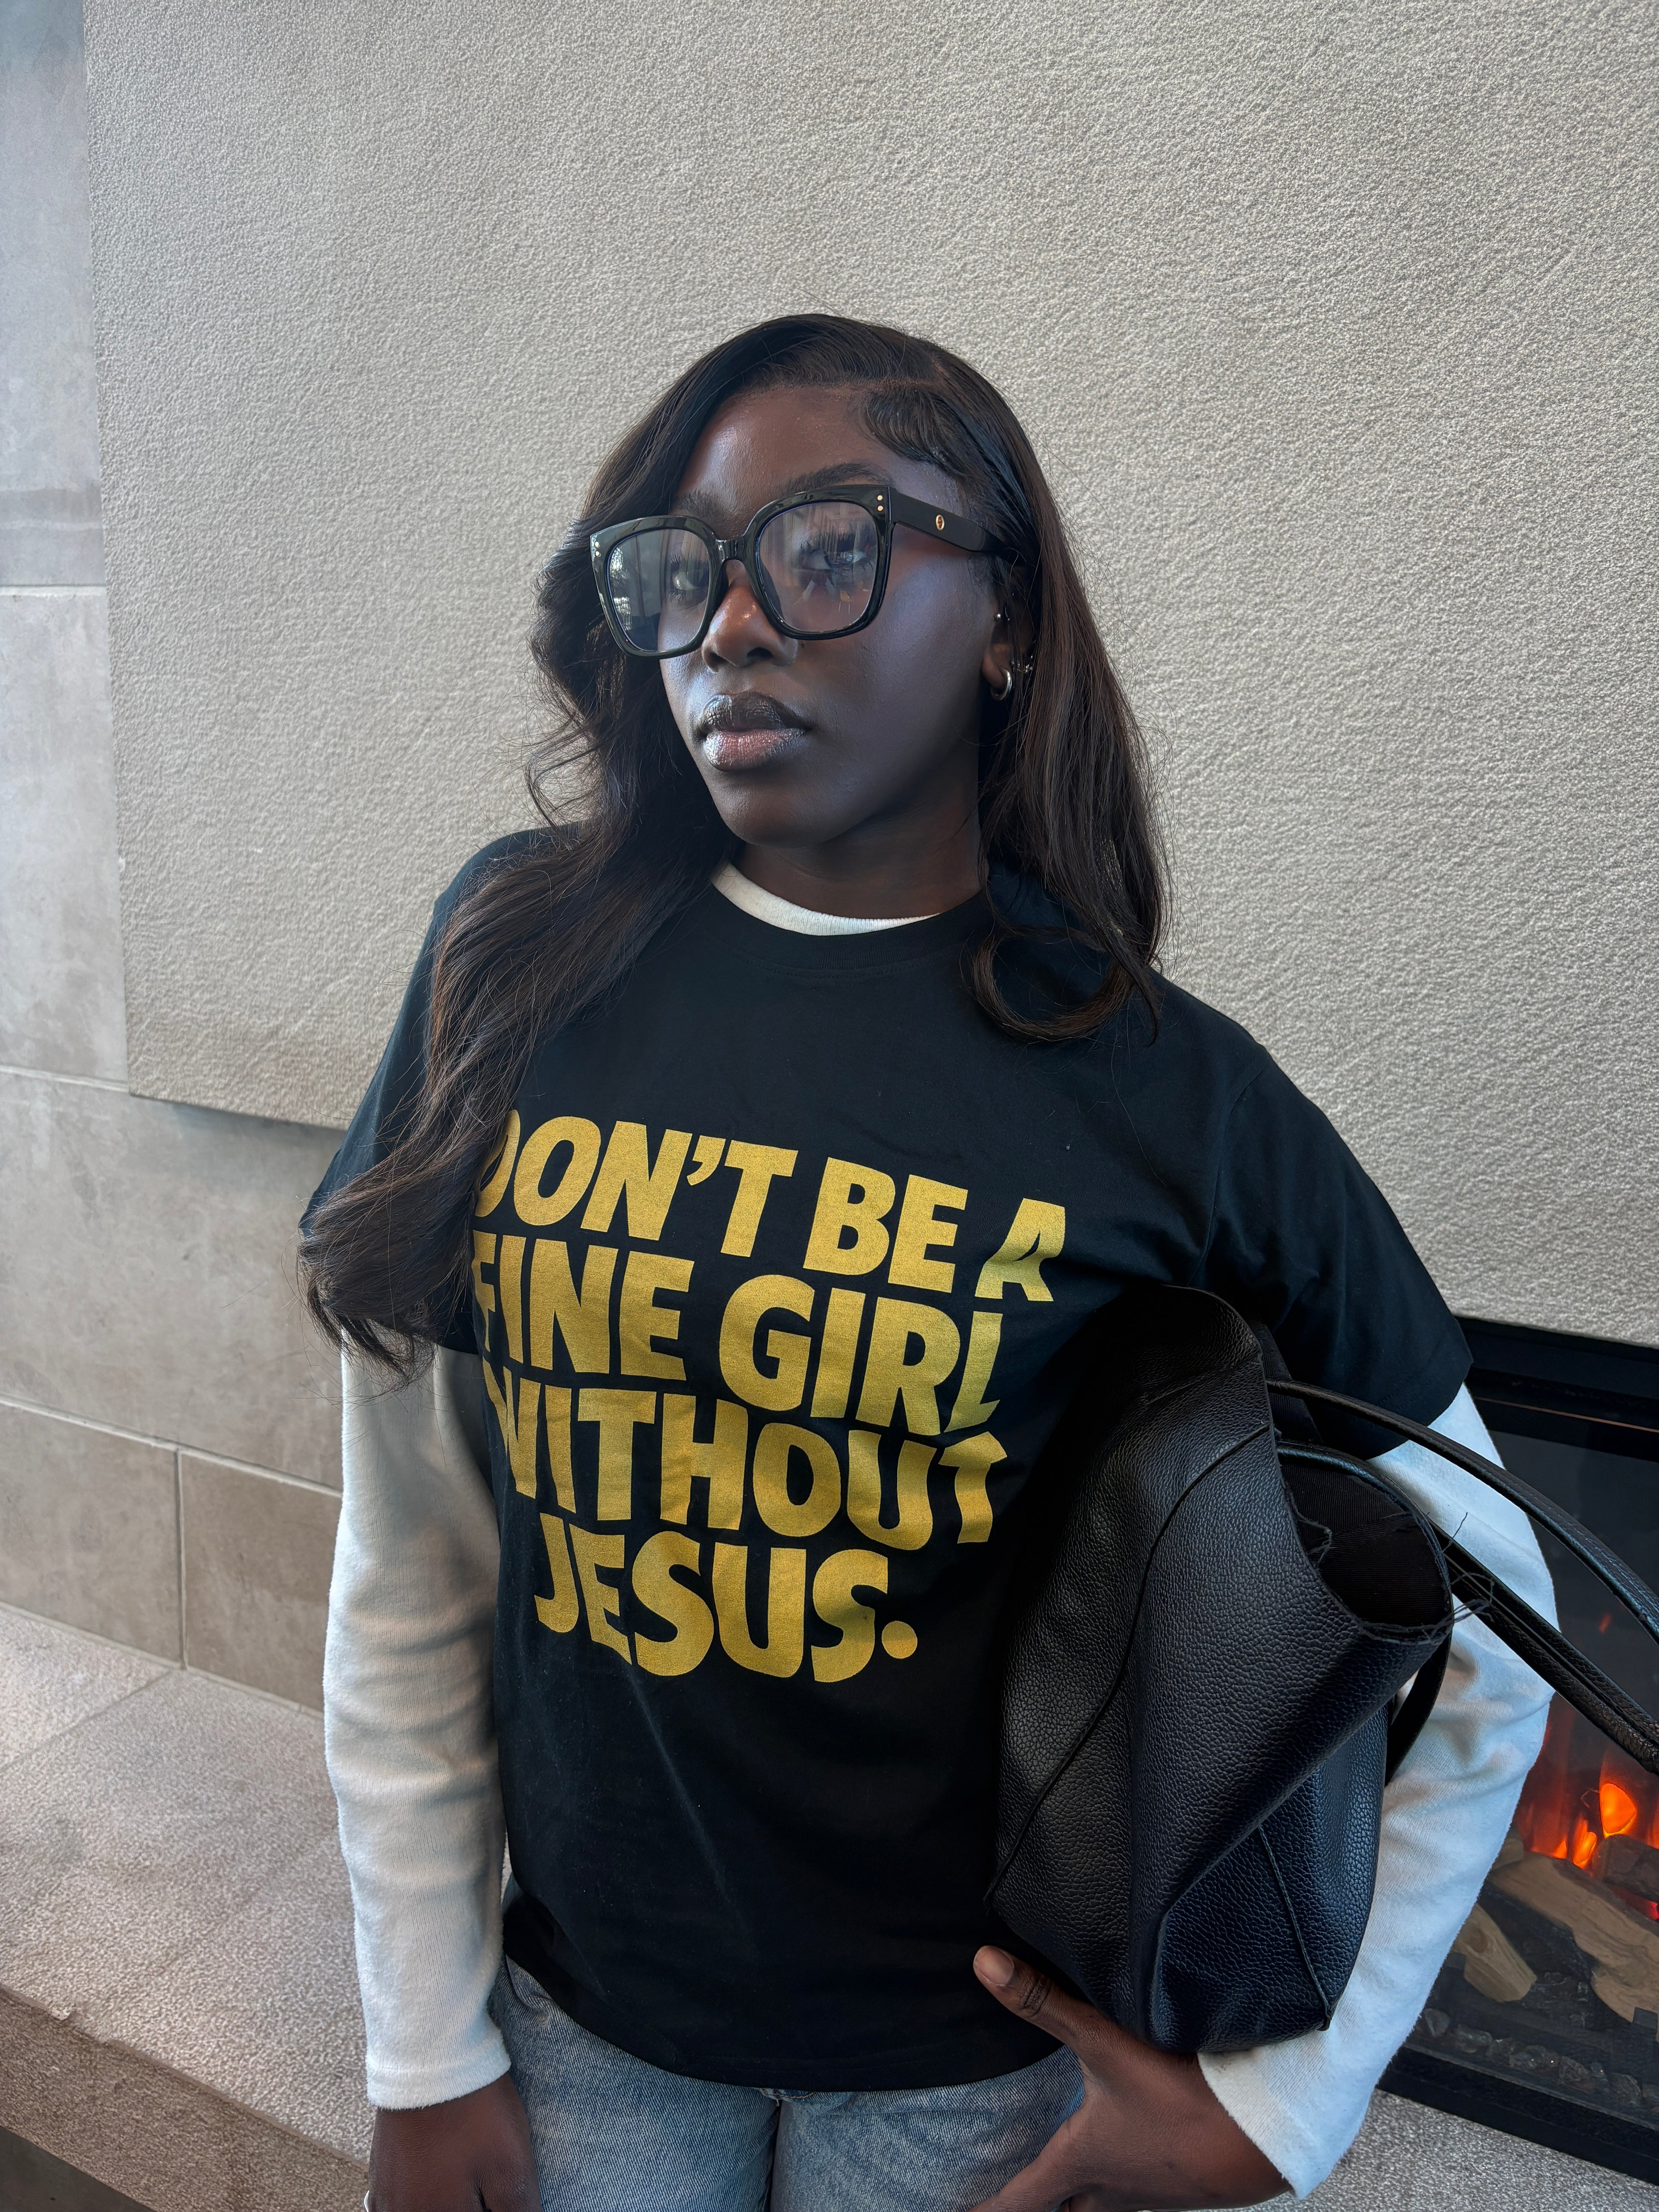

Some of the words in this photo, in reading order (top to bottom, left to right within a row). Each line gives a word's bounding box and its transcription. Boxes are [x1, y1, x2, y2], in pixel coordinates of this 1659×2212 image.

[803, 1157, 968, 1293] BE
[975, 1198, 1066, 1302] A
[471, 1230, 695, 1381] FINE
[719, 1274, 1004, 1436] GIRL
[482, 1356, 1007, 1551] WITHOUT
[534, 1513, 918, 1683] JESUS.
